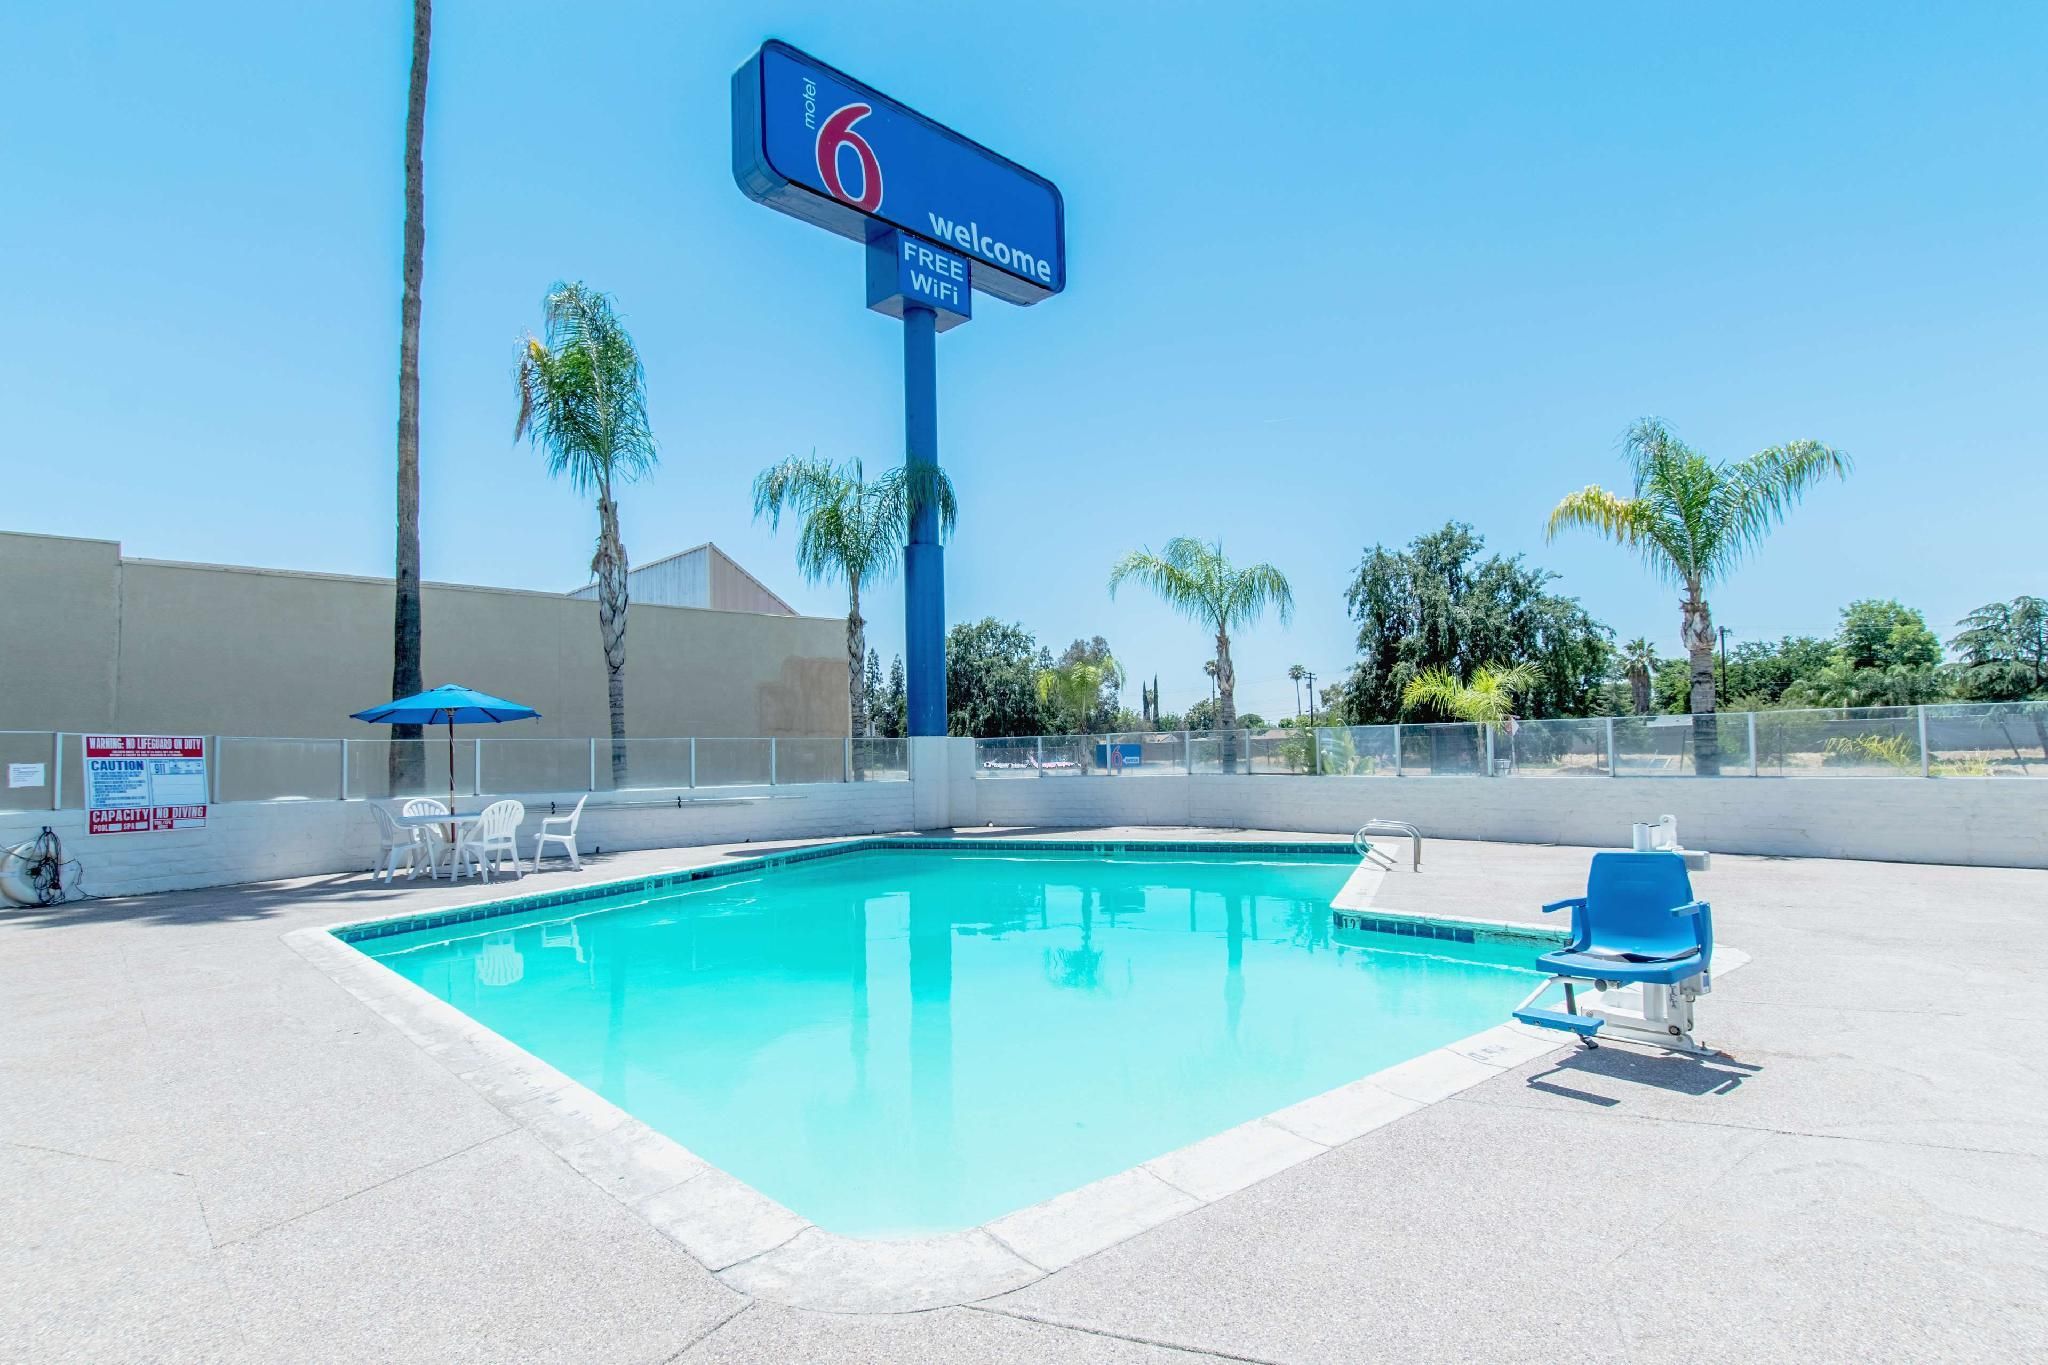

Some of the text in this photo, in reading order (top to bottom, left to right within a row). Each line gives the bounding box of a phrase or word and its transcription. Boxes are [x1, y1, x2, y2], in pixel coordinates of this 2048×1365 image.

[803, 77, 816, 130] motel
[815, 102, 883, 213] 6
[928, 211, 1051, 282] welcome
[904, 241, 964, 282] FREE
[910, 269, 958, 305] WiFi
[125, 737, 136, 749] NO
[137, 738, 172, 750] LIFEGUARD
[173, 738, 183, 749] ON
[184, 738, 201, 750] DUTY
[91, 760, 144, 771] CAUTION
[92, 809, 149, 823] CAPACITY
[156, 806, 204, 819] NO DIVING
[93, 824, 108, 832] POOL
[123, 822, 136, 830] SPA
